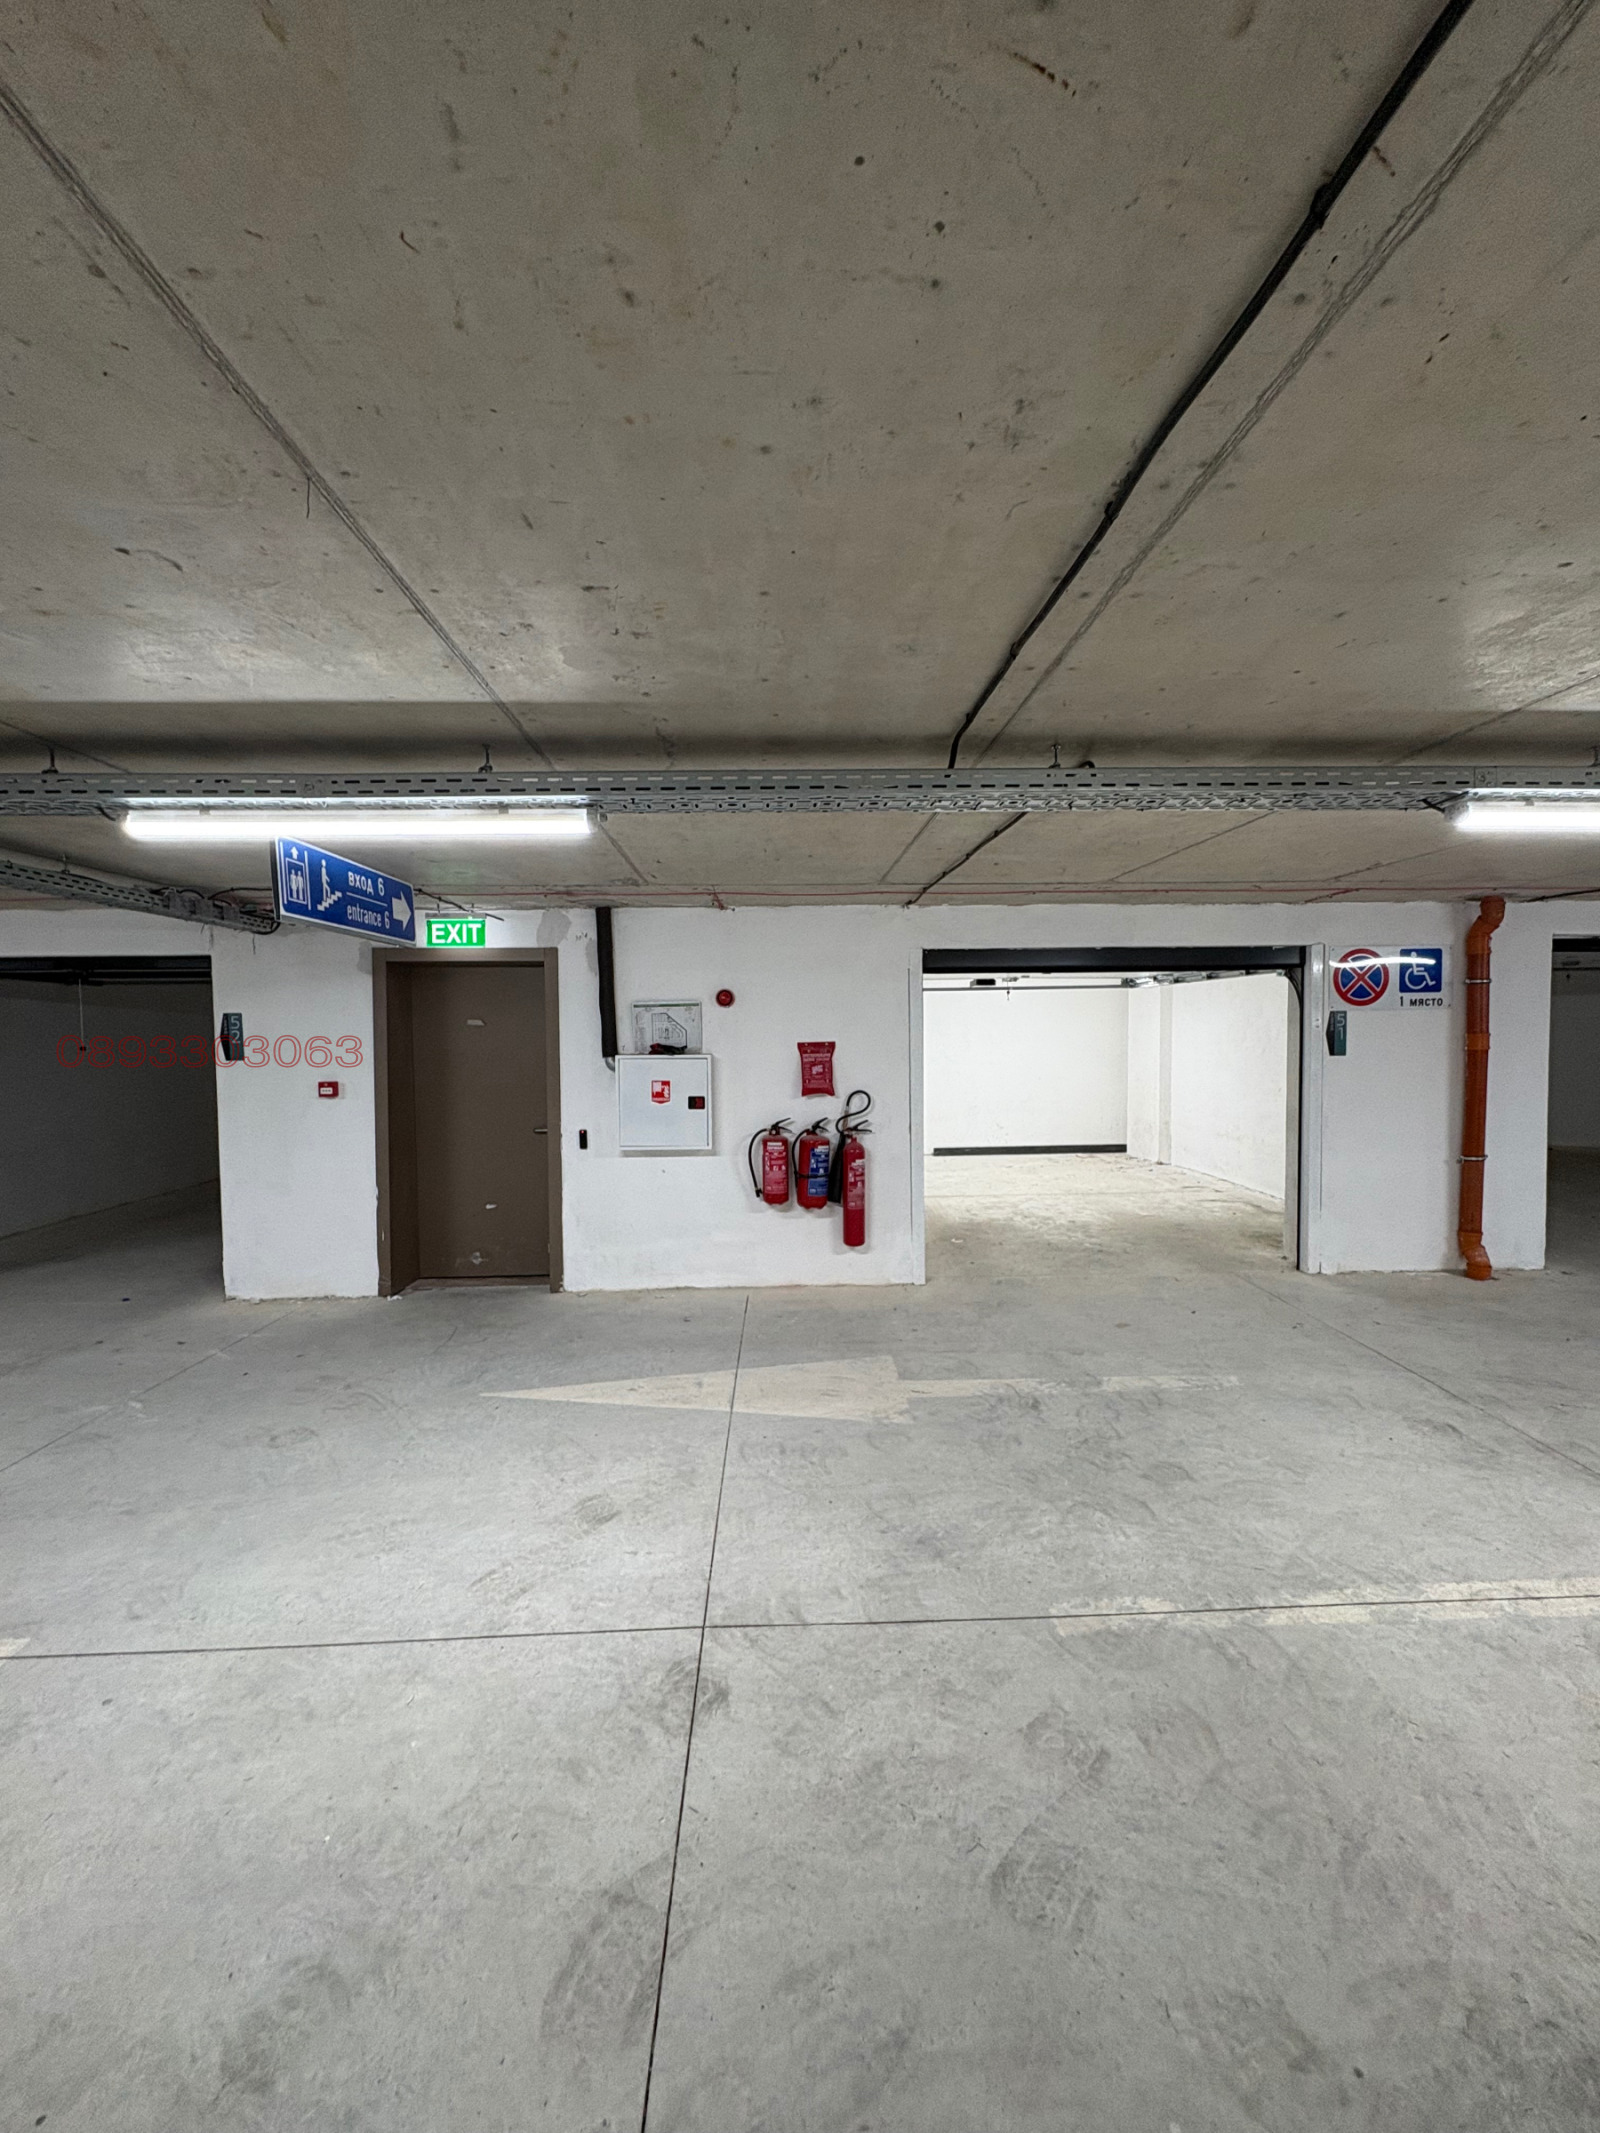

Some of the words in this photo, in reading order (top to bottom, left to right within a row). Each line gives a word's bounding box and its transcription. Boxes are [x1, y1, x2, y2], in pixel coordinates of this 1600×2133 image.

[377, 877, 385, 897] 6
[347, 903, 382, 927] entrance
[384, 911, 390, 929] 6
[431, 922, 482, 944] EXIT
